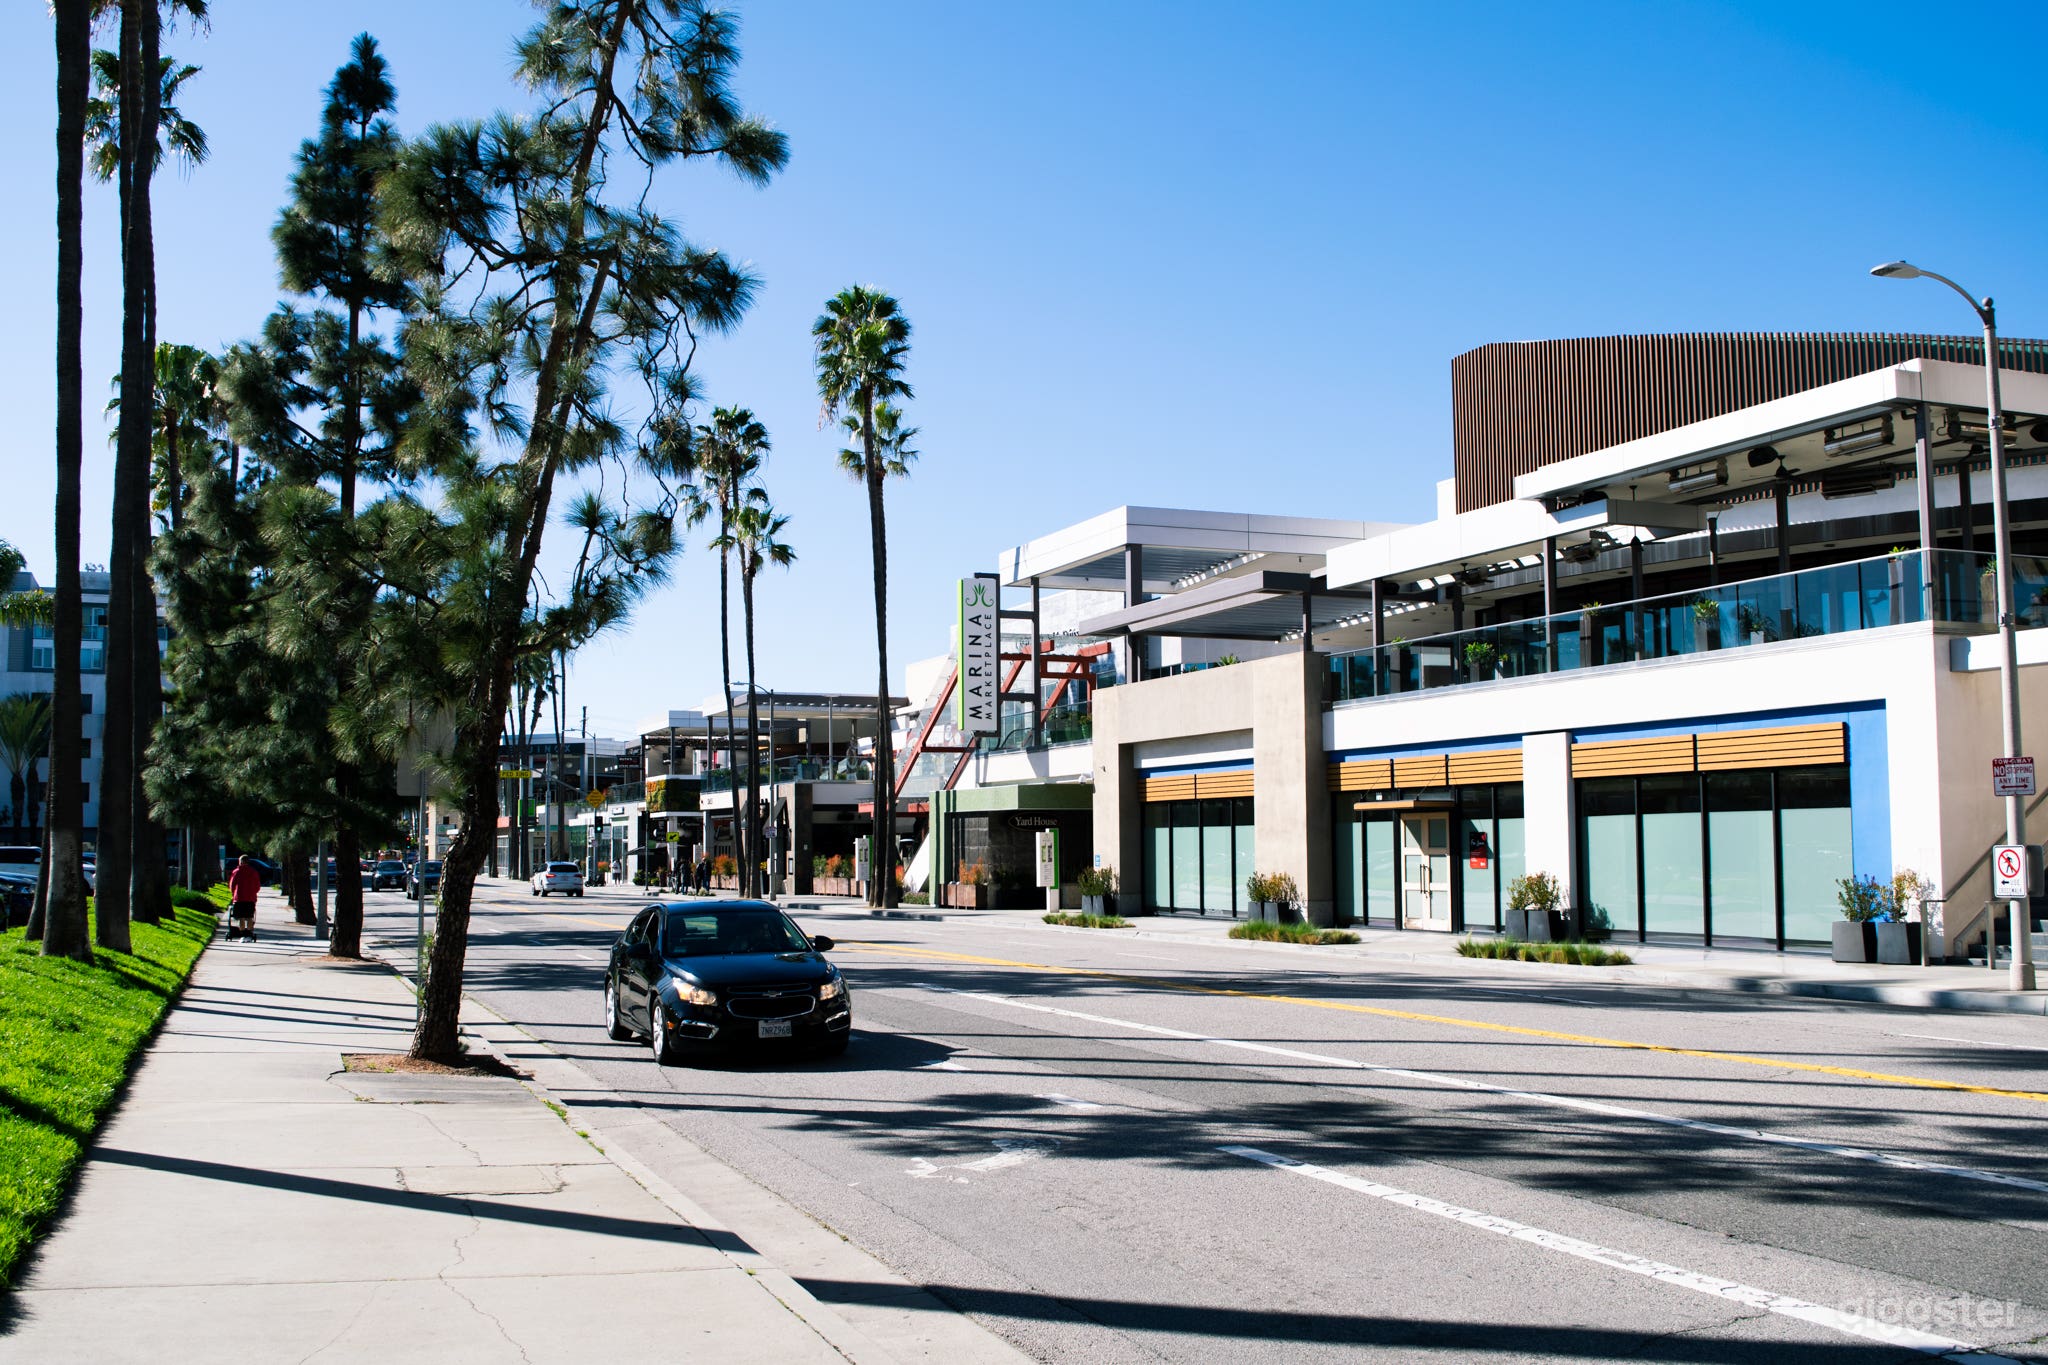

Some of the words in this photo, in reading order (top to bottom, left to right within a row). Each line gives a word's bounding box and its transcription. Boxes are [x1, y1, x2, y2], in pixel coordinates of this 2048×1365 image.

[968, 614, 982, 720] MARINA
[984, 613, 993, 720] MARKETPLACE
[1994, 765, 2005, 776] NO
[2006, 766, 2033, 774] STOPPING
[1015, 816, 1033, 826] Yard
[1034, 816, 1058, 826] House
